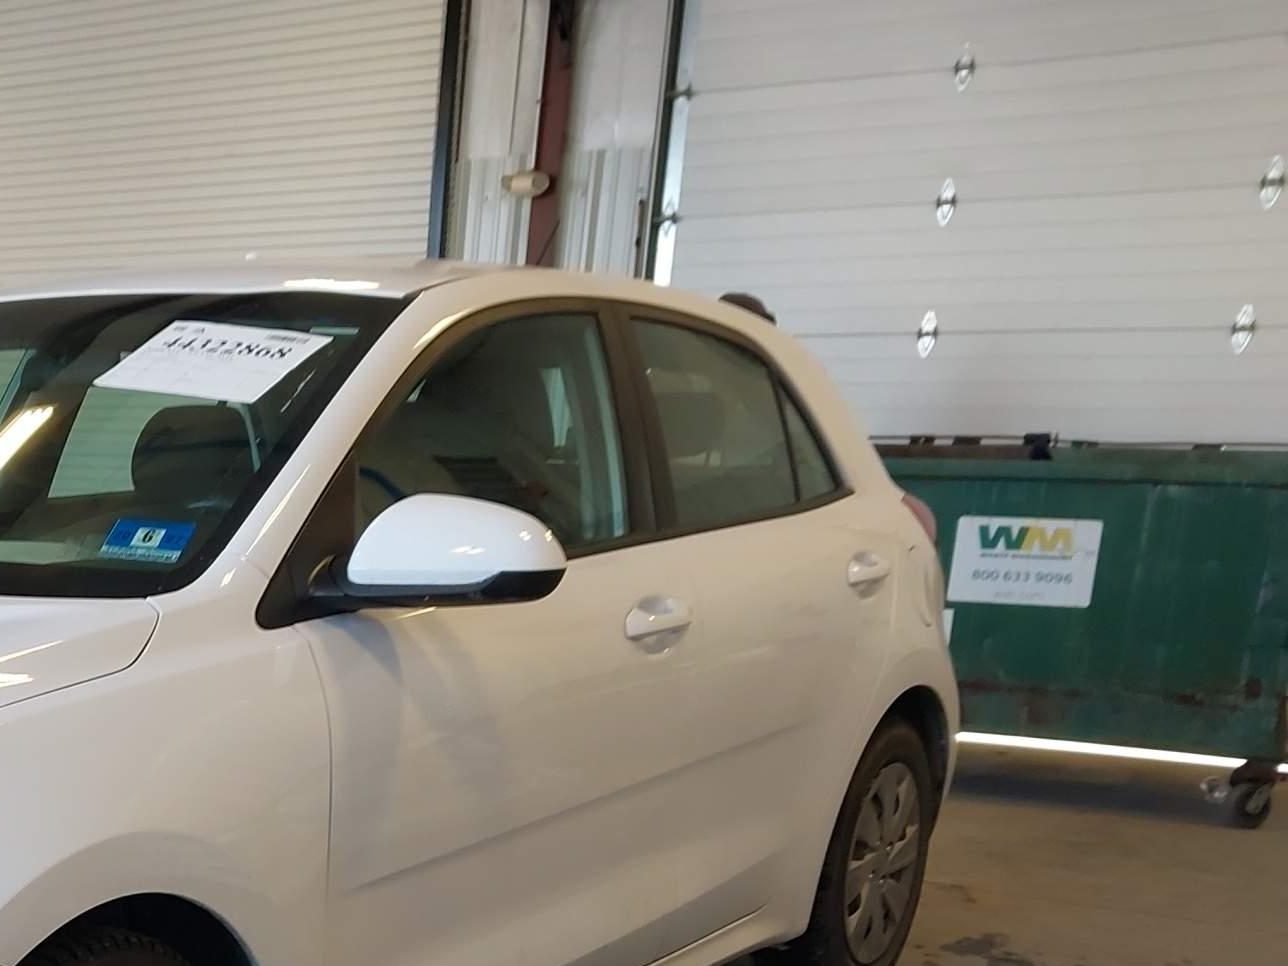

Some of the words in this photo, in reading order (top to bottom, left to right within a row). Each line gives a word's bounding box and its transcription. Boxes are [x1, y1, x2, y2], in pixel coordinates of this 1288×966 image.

[142, 528, 154, 544] 6
[978, 524, 1074, 554] WM
[971, 569, 1000, 581] 800
[1003, 570, 1031, 582] 633
